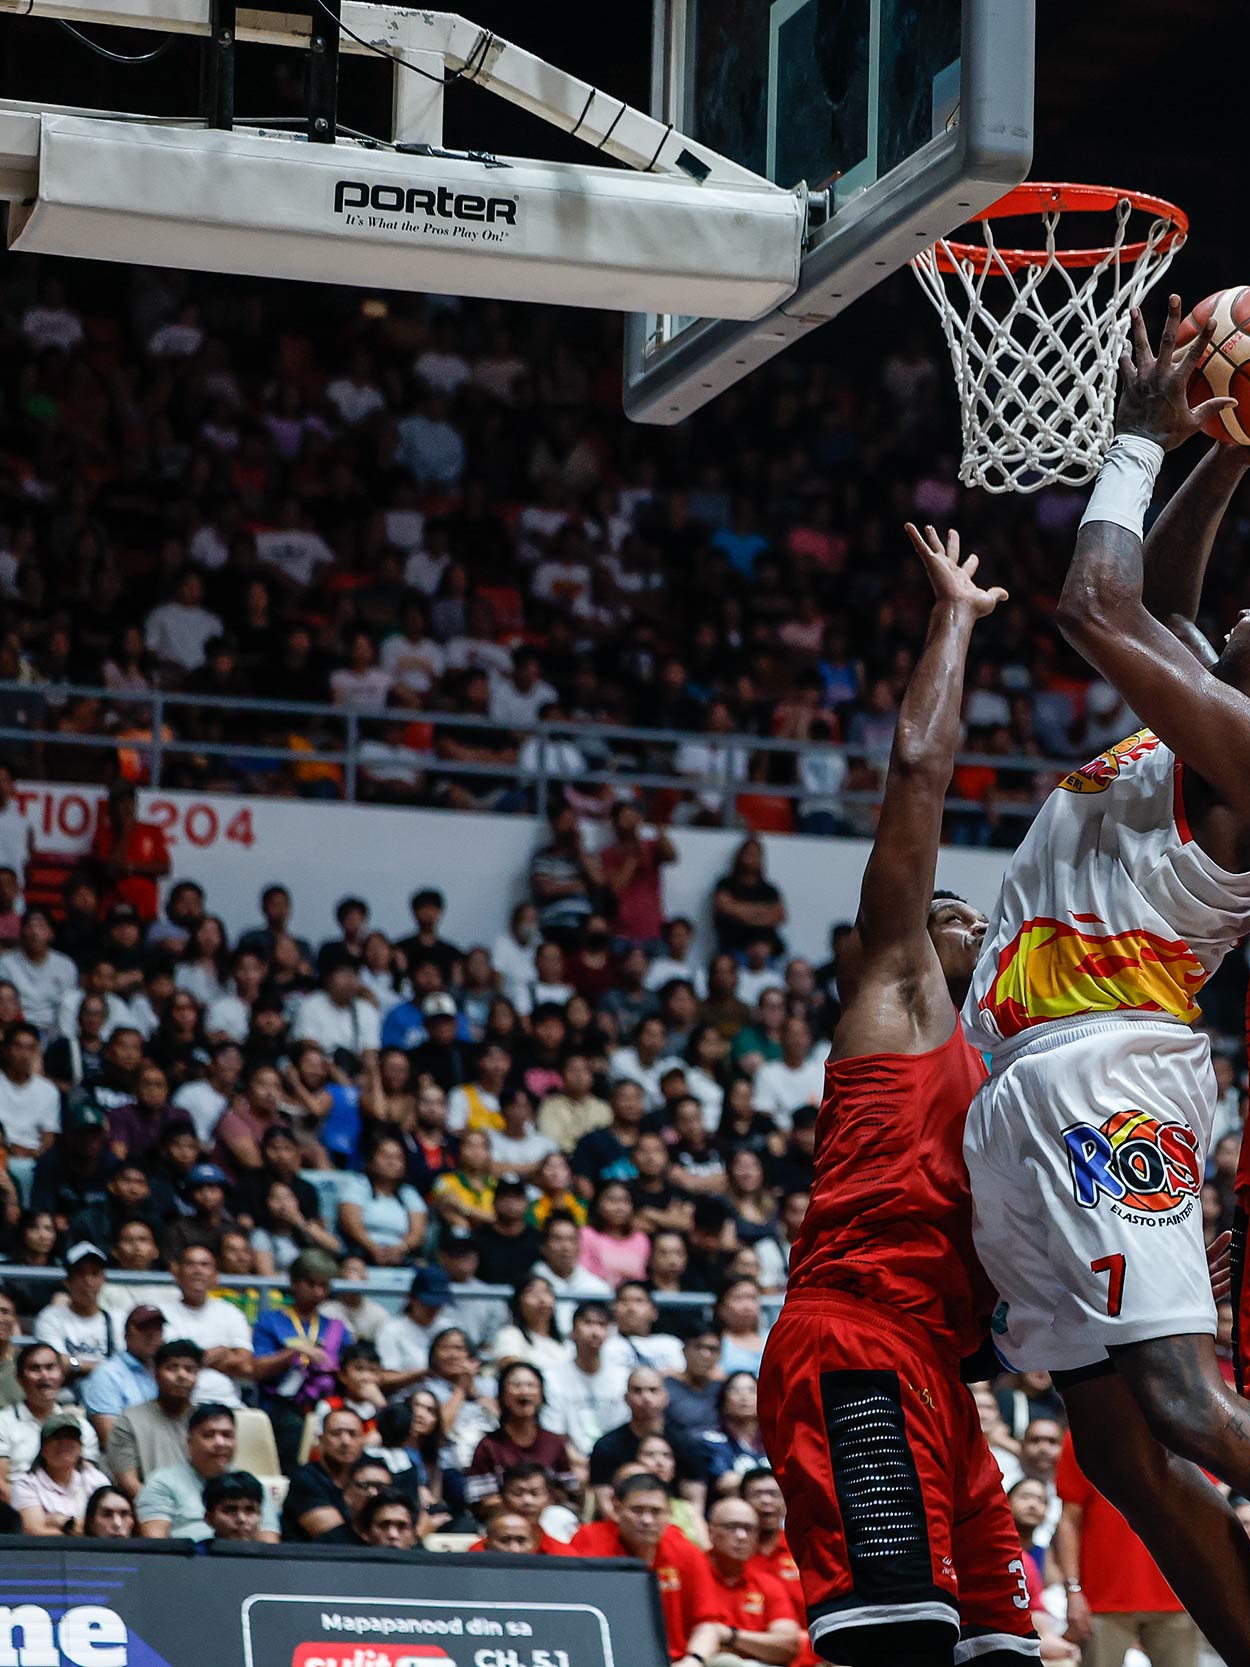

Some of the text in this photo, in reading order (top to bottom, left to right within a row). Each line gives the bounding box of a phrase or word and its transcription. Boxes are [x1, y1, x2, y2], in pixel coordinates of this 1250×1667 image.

[345, 214, 505, 242] It's What the Pros Play On!
[149, 800, 256, 849] 204
[1110, 1204, 1156, 1227] ELASTO
[1090, 1252, 1127, 1318] 7
[1008, 1559, 1030, 1610] 3
[321, 1613, 533, 1637] Mapapanood din sa
